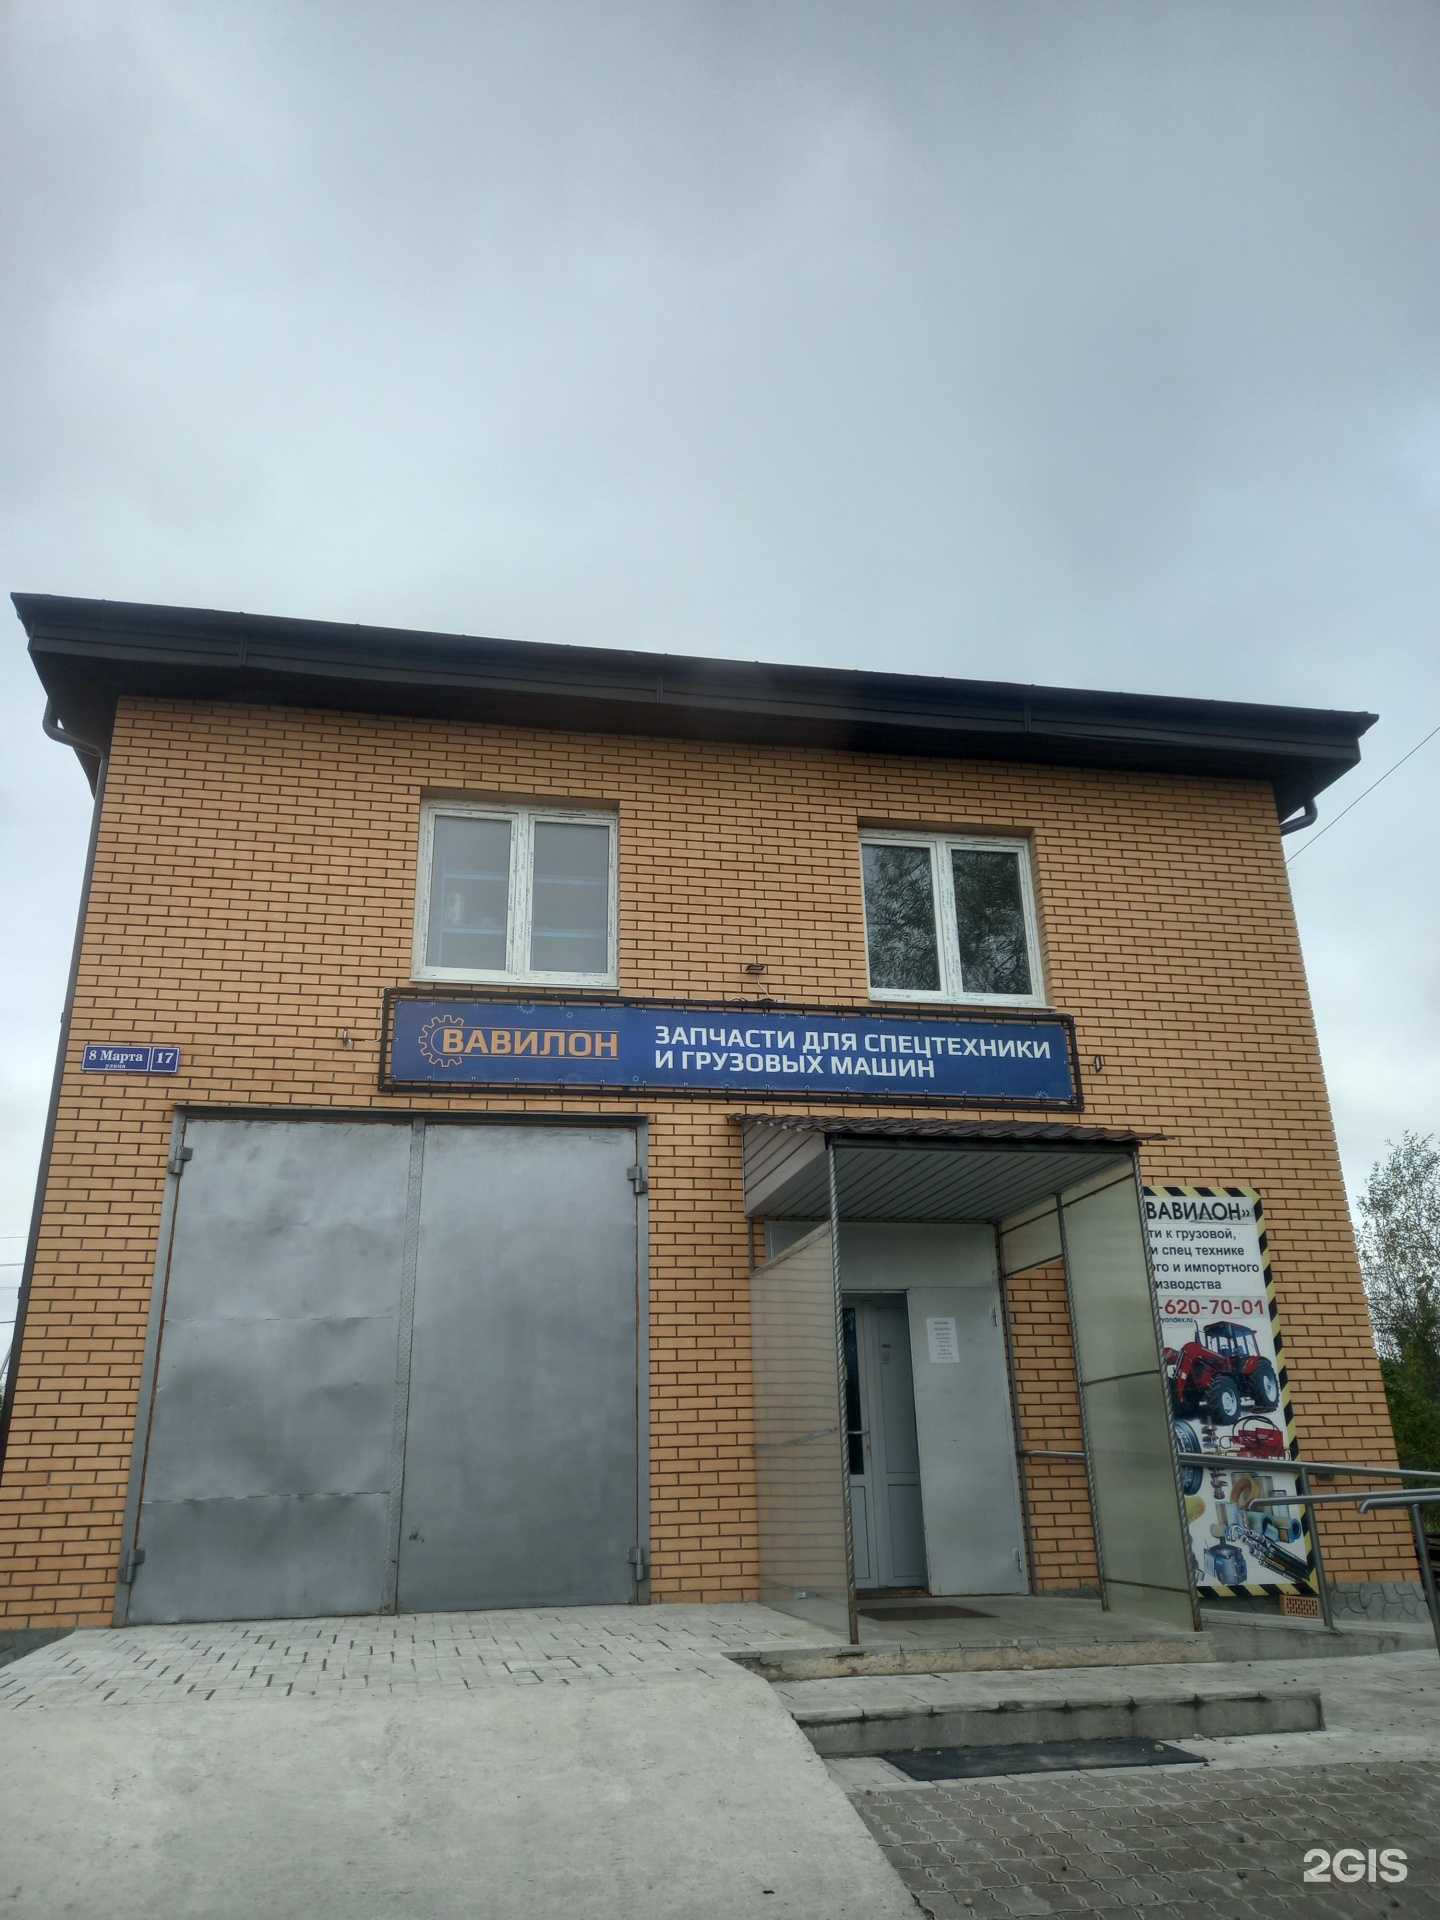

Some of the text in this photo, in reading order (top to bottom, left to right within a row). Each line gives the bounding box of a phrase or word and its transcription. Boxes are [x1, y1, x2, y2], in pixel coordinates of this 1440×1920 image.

[442, 1028, 618, 1057] ВАВИЛОН
[655, 1025, 1051, 1059] ЗАПЧАСТИ ДЛЯ СПЕЦТЕХНИКИ
[88, 1049, 143, 1063] 8 Марта
[156, 1052, 174, 1064] 17
[655, 1050, 935, 1078] И ГРУЗОВЫХ МАШИН
[1166, 1230, 1173, 1239] к
[1176, 1228, 1237, 1241] грузовой,
[1162, 1246, 1193, 1257] спец
[1195, 1247, 1245, 1256] технике
[1172, 1263, 1181, 1272] и
[1184, 1263, 1260, 1275] импортного
